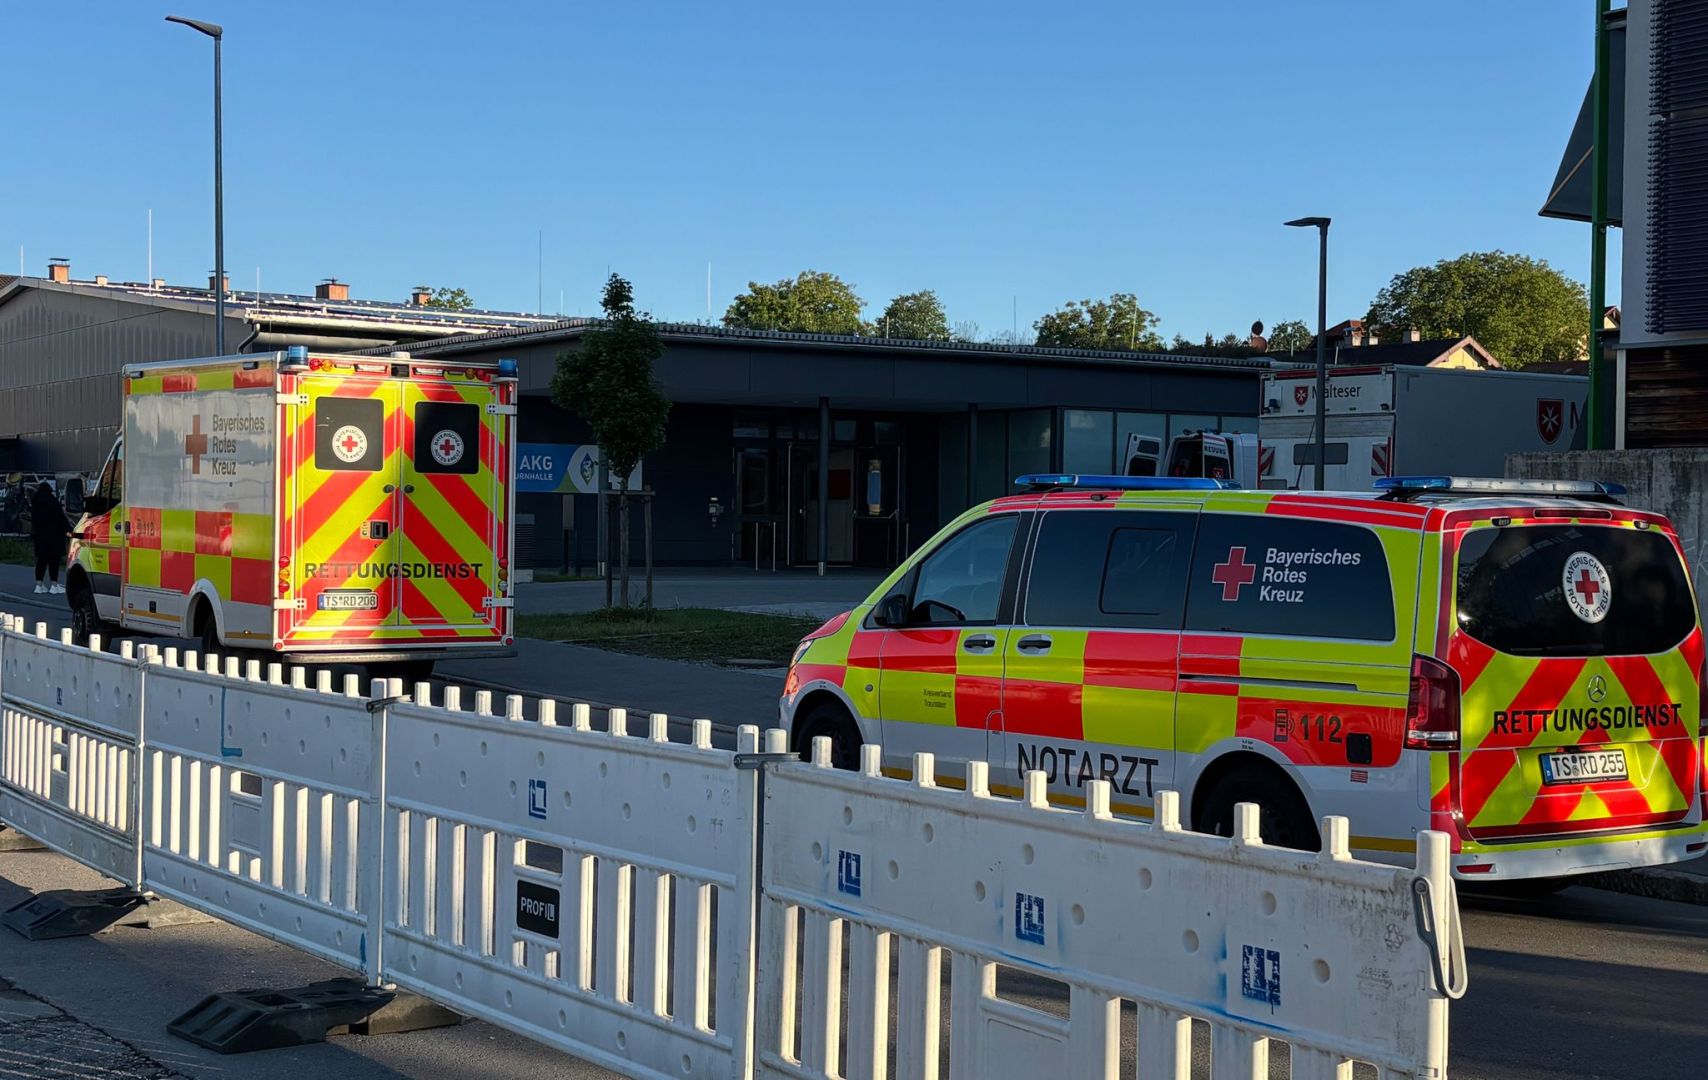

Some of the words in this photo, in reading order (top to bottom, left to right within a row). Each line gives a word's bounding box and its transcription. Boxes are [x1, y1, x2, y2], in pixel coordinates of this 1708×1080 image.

[212, 412, 265, 435] Bayerisches
[212, 436, 237, 453] Rotes
[212, 457, 237, 475] Kreuz
[519, 455, 553, 471] AKG
[1265, 547, 1361, 567] Bayerisches
[304, 562, 483, 579] RETTUNGSDIENST
[1262, 566, 1307, 583] Rotes
[1565, 556, 1606, 584] BAYERISCHES
[1260, 585, 1304, 603] Kreuz
[1567, 588, 1590, 618] ROTES
[1592, 588, 1609, 618] KREUZ
[1300, 714, 1343, 743] 112
[1493, 703, 1682, 735] RETTUNGSDIENST
[1017, 743, 1159, 798] NOTARZT
